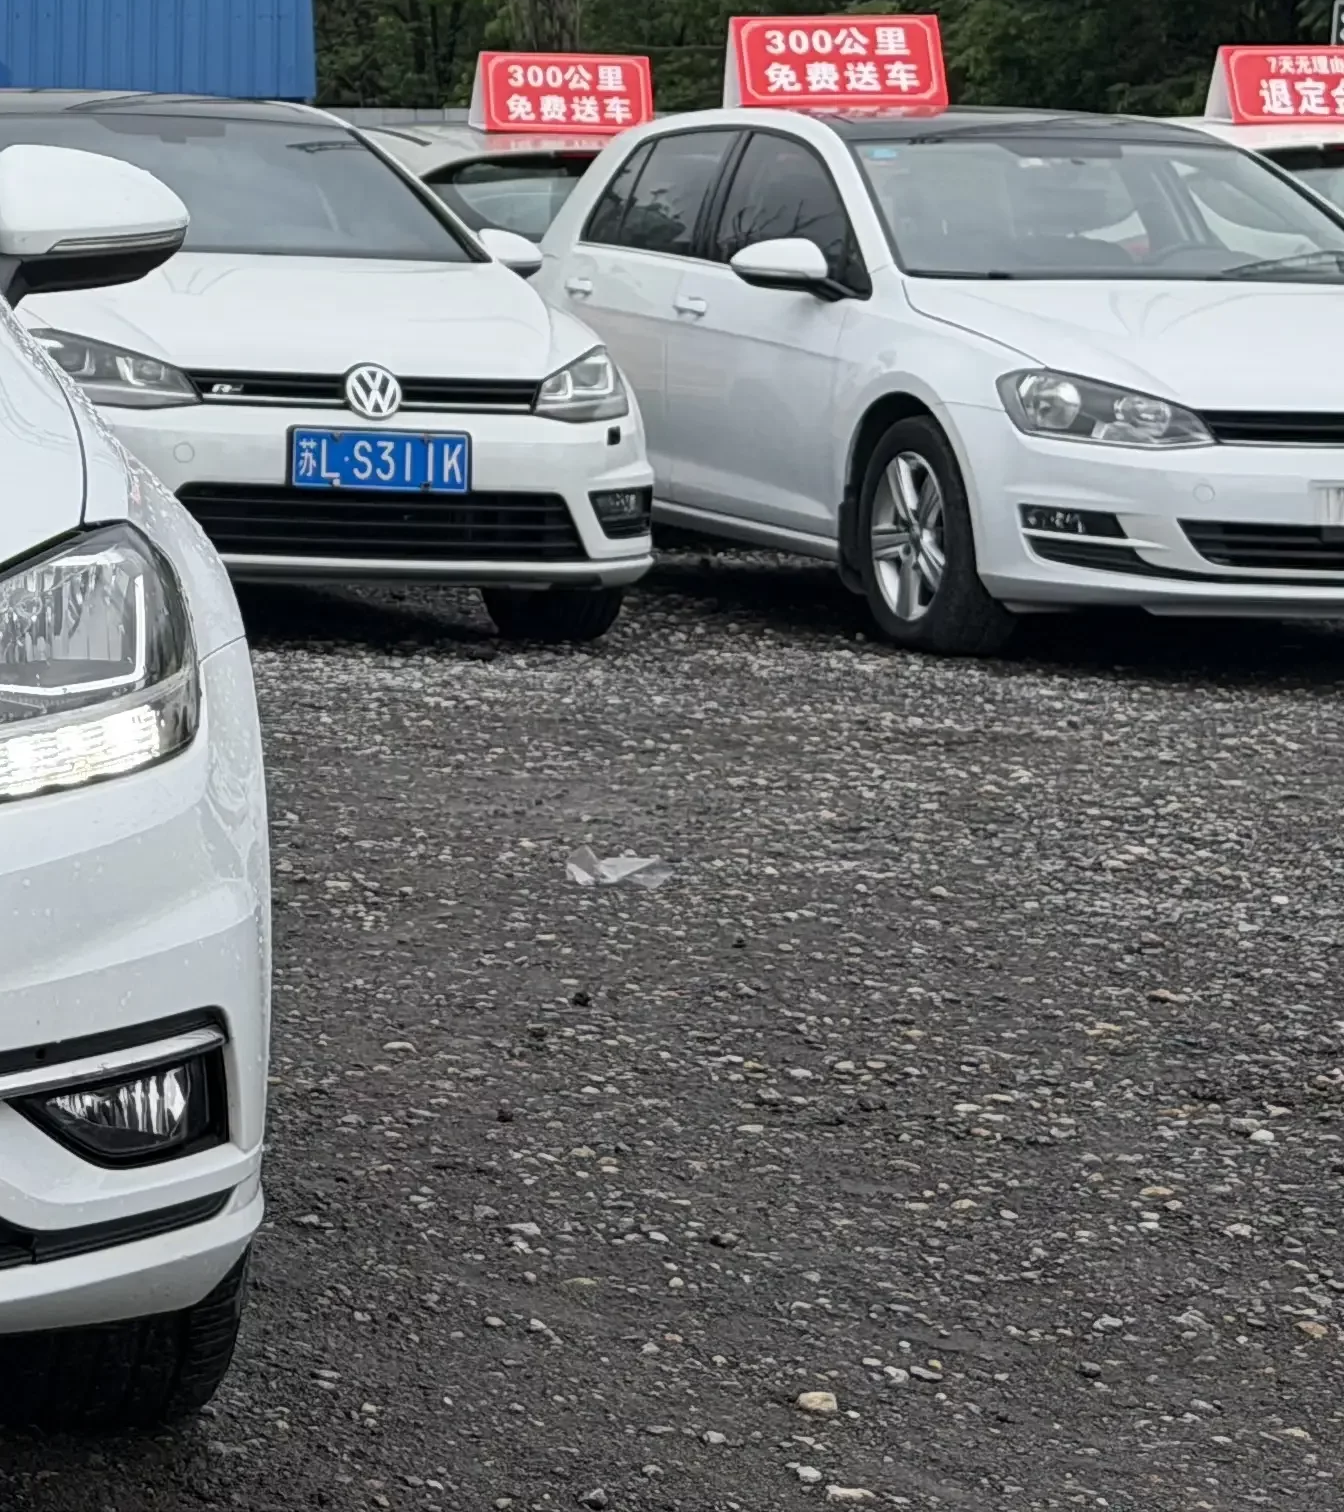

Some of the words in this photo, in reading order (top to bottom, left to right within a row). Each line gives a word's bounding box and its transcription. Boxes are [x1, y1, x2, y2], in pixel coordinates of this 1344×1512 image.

[765, 27, 911, 56] 300公里
[507, 64, 627, 92] 300公里
[764, 61, 921, 93] 免费送车
[506, 93, 633, 124] 免费送车
